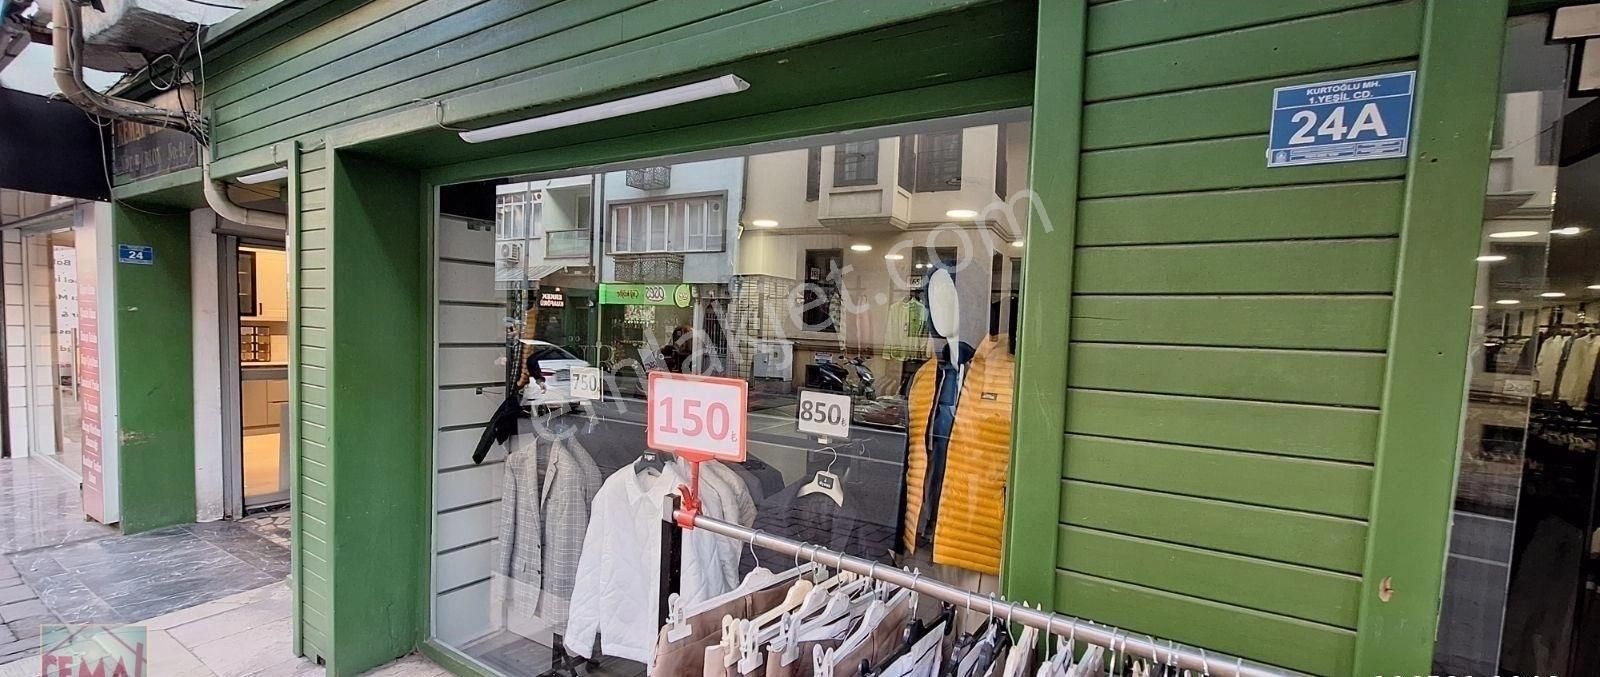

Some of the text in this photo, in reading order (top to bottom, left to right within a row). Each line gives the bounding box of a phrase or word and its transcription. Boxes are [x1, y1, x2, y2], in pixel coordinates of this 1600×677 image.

[1306, 80, 1381, 96] KURTOĞLU MH.
[1352, 90, 1374, 99] CD.
[1288, 102, 1389, 145] 24A
[128, 250, 144, 260] 24
